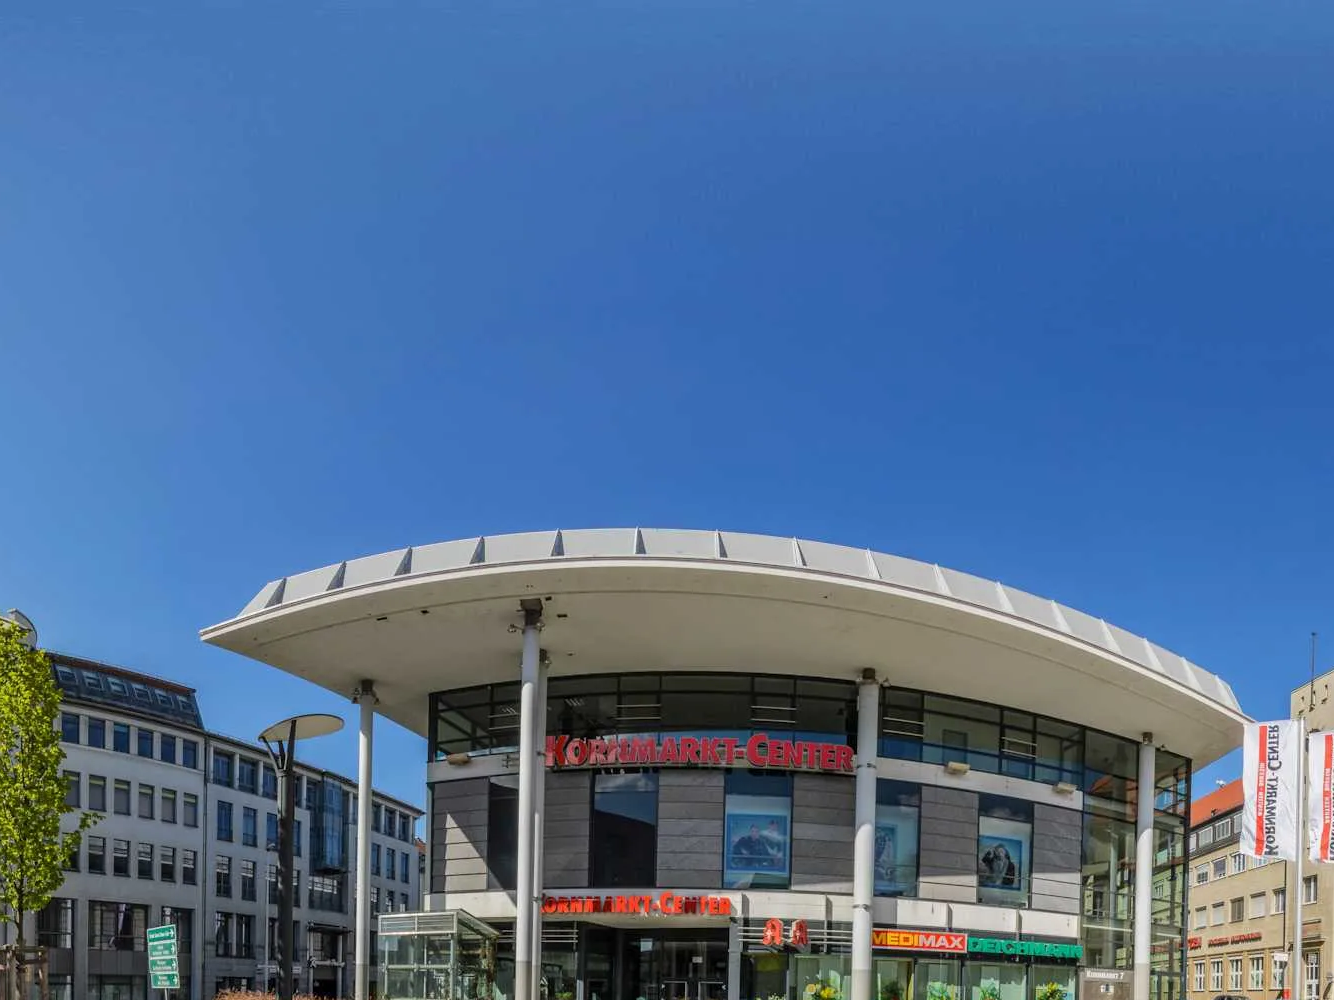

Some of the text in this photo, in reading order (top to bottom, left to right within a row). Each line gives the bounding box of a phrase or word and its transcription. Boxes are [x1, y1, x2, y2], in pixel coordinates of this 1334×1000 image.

[546, 733, 855, 771] KORNMARKT-CENTER
[541, 890, 732, 915] ORNMARKT-CENTER
[872, 931, 964, 949] MEDIMAX
[968, 937, 1083, 959] DEICHMANN
